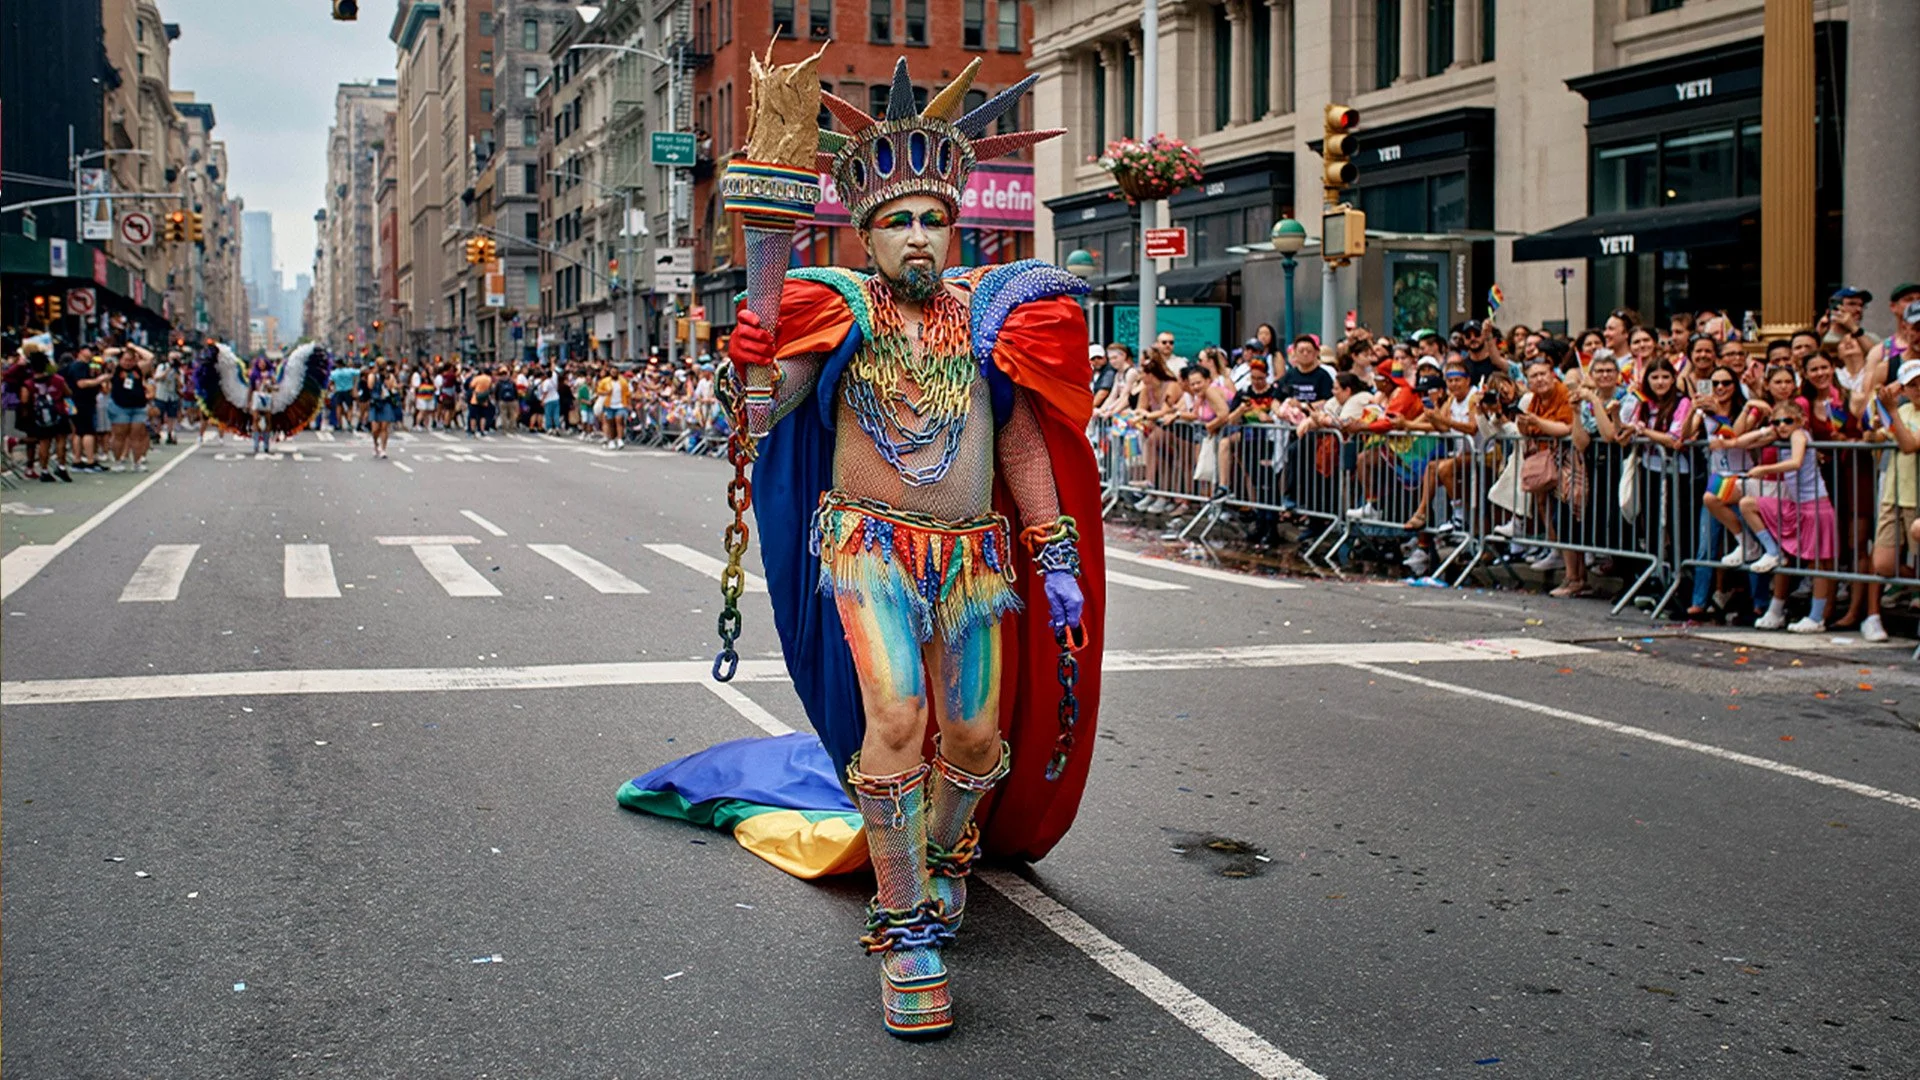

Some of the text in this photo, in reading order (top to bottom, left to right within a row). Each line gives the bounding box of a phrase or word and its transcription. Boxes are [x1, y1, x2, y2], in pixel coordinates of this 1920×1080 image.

[1675, 78, 1712, 100] YETI
[654, 135, 692, 144] West Side
[656, 144, 690, 153] Highway
[1378, 144, 1401, 162] YETI
[1600, 235, 1634, 255] YETI
[1456, 253, 1466, 313] Newsstand
